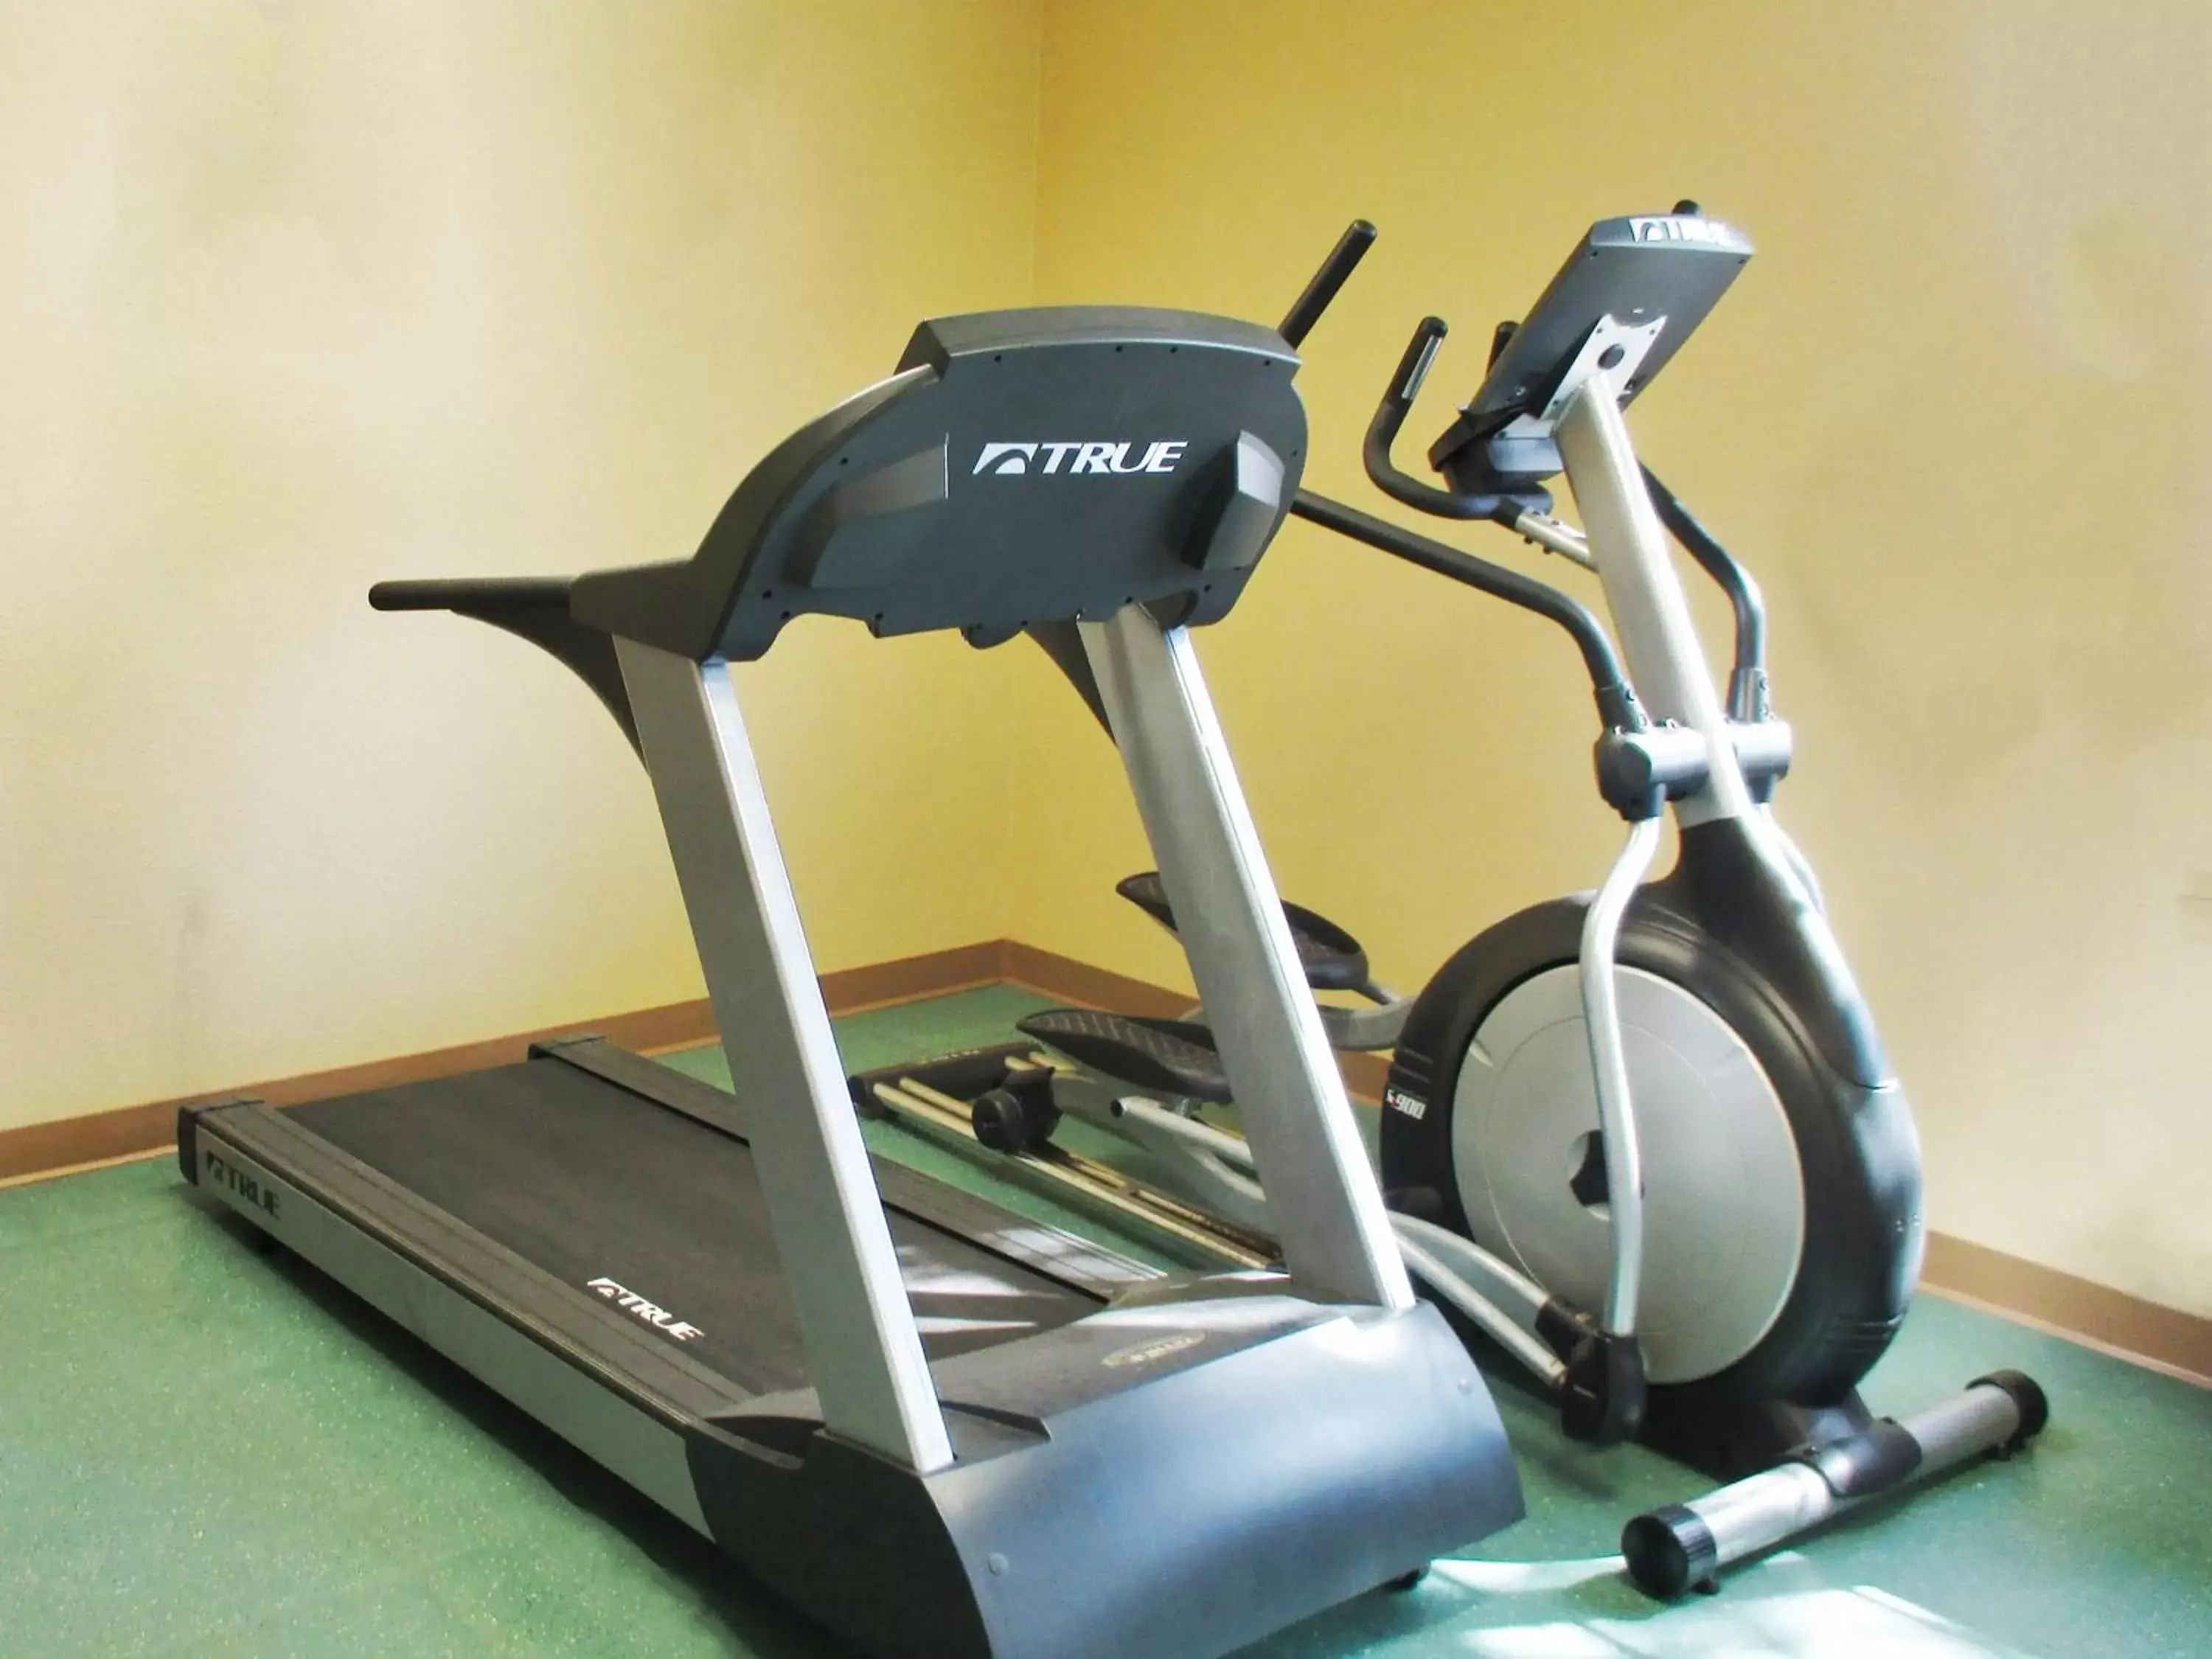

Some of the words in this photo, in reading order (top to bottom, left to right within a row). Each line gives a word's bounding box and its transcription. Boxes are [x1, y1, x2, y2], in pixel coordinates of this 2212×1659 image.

[1040, 442, 1189, 473] TRUE
[229, 1167, 280, 1221] TRUE
[619, 1290, 704, 1341] TRUE
